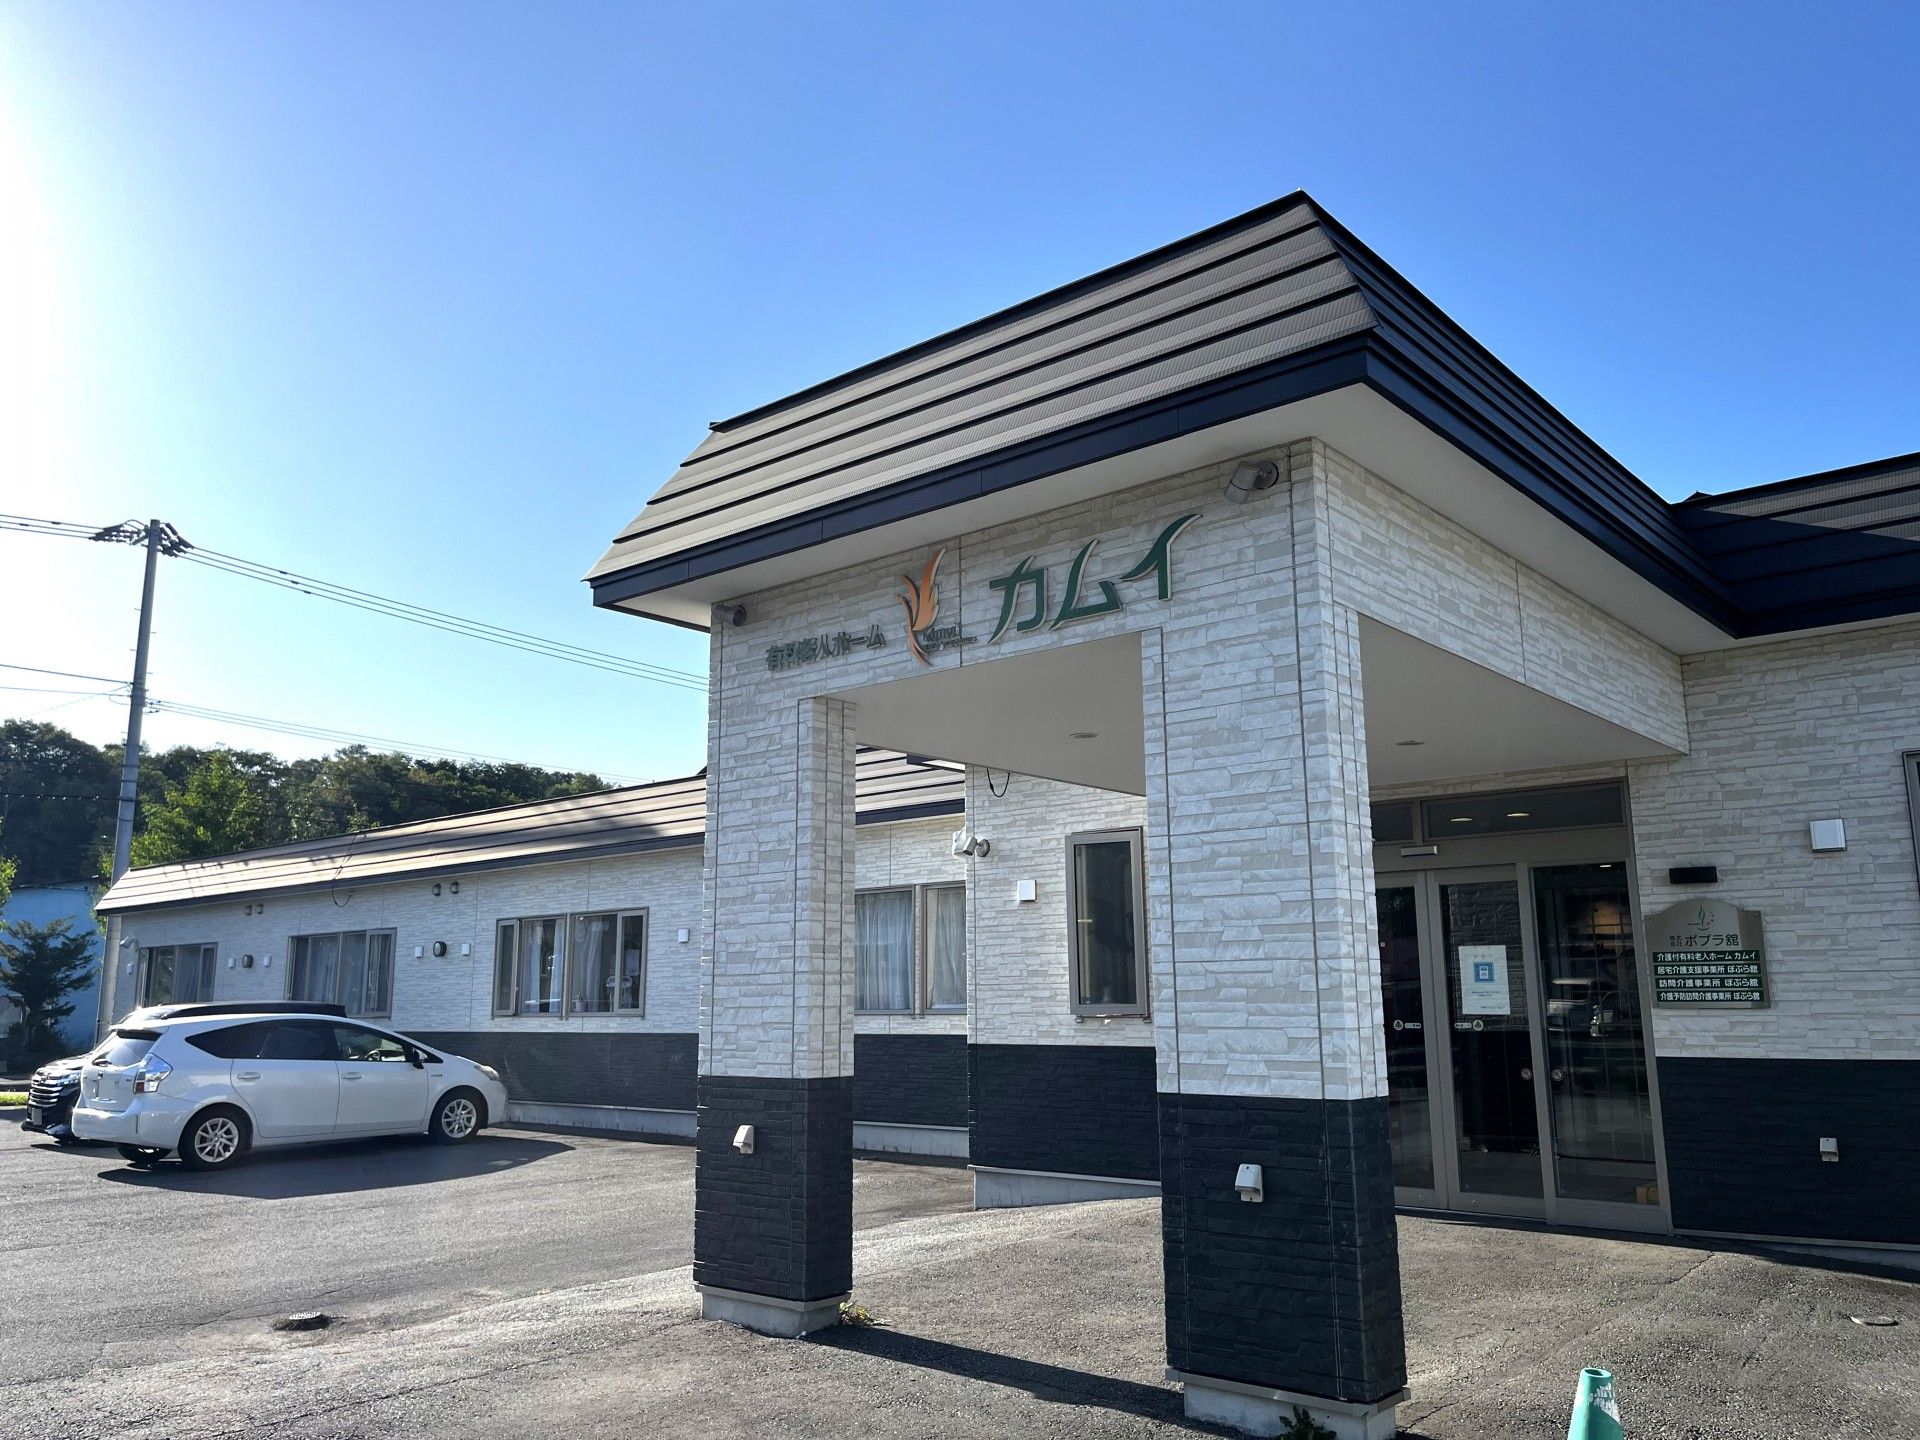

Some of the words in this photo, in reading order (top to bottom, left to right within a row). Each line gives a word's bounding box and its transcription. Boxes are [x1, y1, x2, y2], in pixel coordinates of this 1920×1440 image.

[987, 513, 1203, 645] カムイ
[1657, 952, 1732, 961] 介護付有料老人ホーム
[1734, 952, 1756, 960] カムイ
[1657, 965, 1725, 974] 居宅介護支援事業所
[1659, 979, 1721, 987] 訪問介護事業所
